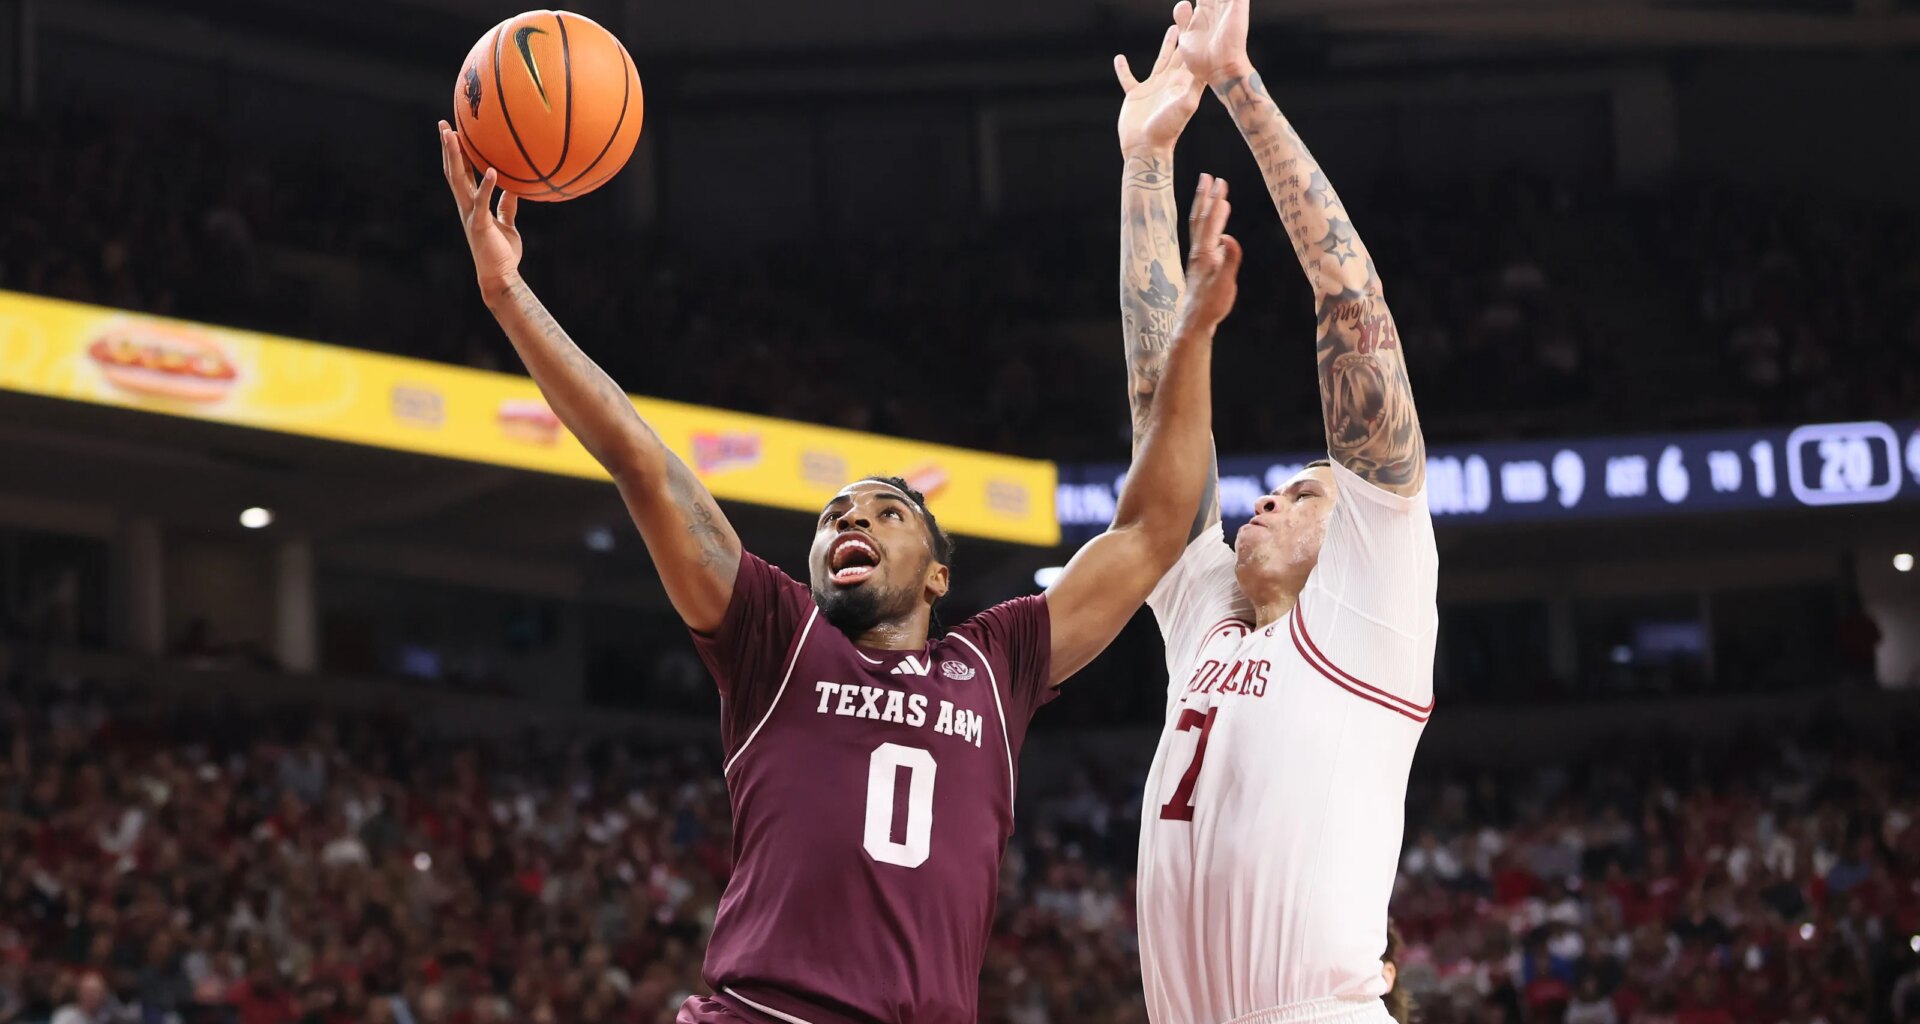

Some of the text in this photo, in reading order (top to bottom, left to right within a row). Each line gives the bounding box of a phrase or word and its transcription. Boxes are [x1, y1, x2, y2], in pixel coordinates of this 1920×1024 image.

[1552, 449, 1585, 508] 9
[1657, 445, 1690, 503] 6
[1749, 440, 1777, 498] 1
[1818, 436, 1874, 493] 20
[815, 681, 984, 748] TEXAS A&M
[863, 742, 938, 869] 0
[1159, 706, 1218, 822] 7
